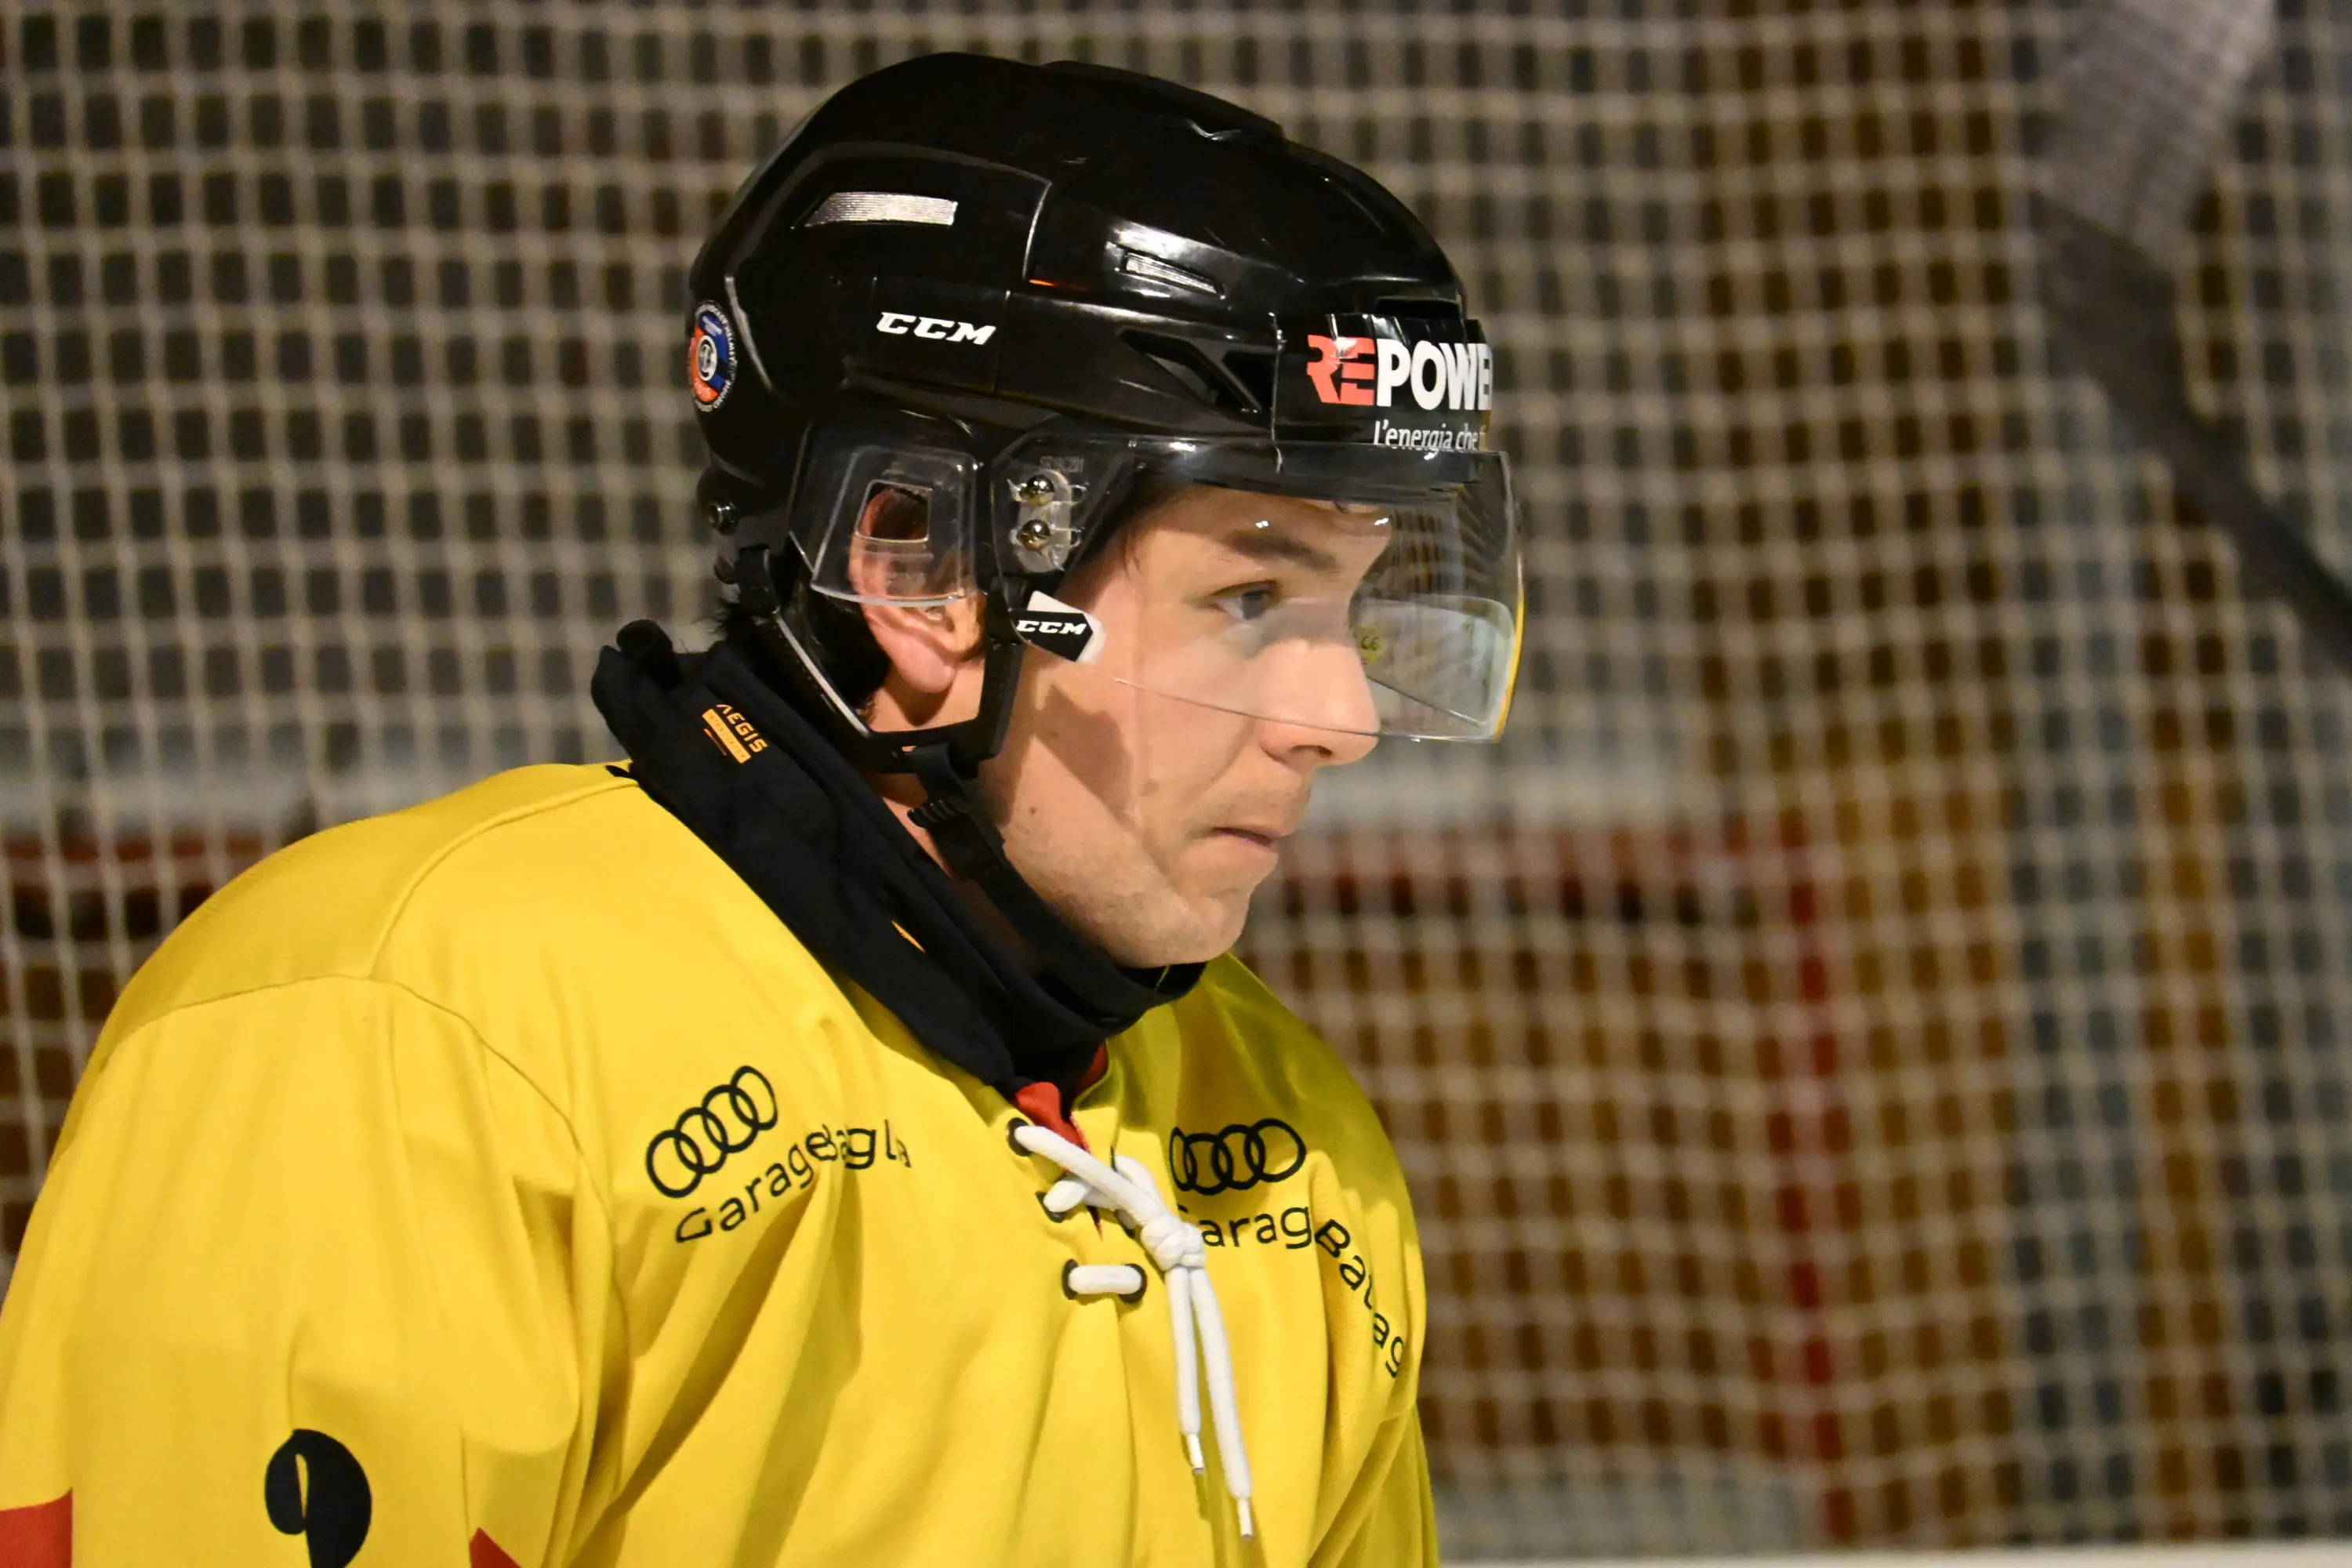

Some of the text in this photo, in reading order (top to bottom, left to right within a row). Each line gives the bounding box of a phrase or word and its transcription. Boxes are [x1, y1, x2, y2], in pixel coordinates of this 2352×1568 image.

[876, 311, 997, 346] CCM
[1306, 334, 1493, 411] REPOWE
[1455, 423, 1479, 452] che
[1015, 619, 1088, 636] CCM
[716, 704, 768, 753] AEGIS
